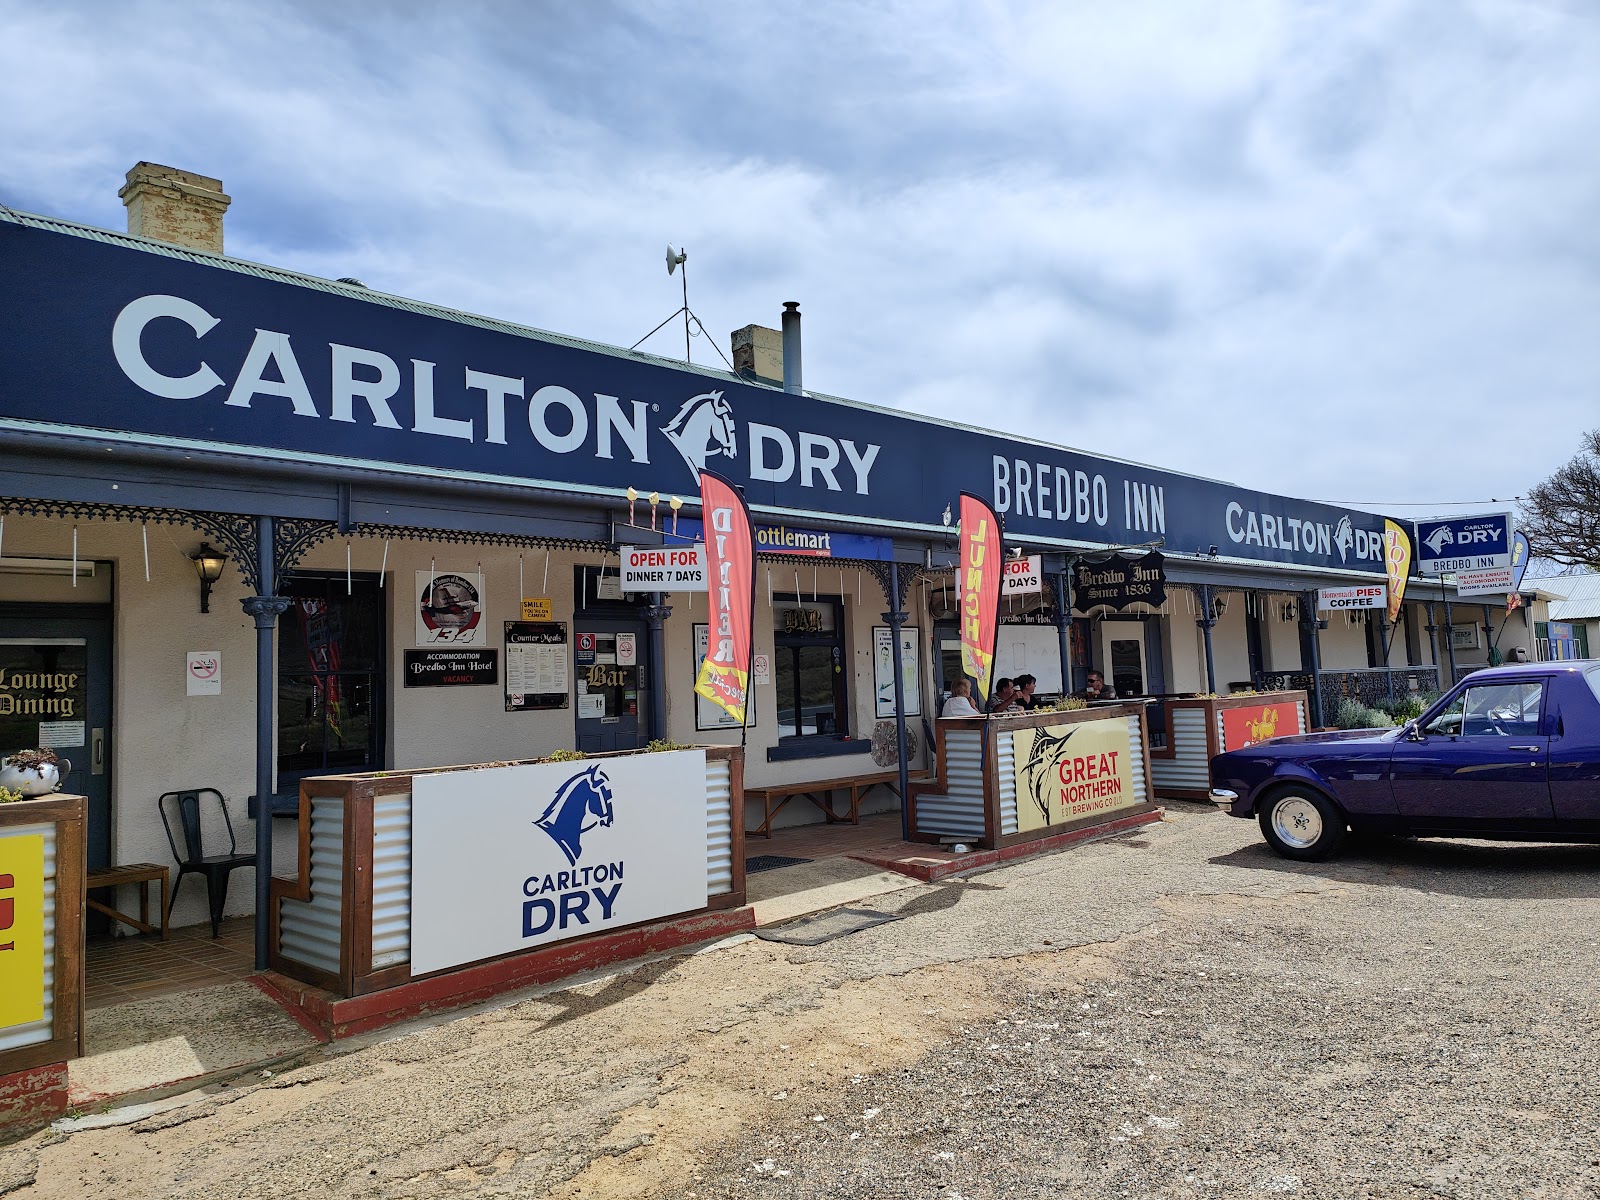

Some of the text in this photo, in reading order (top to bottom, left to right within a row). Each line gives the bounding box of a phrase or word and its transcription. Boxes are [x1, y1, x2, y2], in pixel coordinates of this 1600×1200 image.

[112, 294, 881, 495] CARLTON DRY
[992, 455, 1166, 534] BREDBO INN
[1225, 501, 1332, 556] CARLTON
[1464, 523, 1494, 531] CARLTON
[754, 526, 831, 549] ottlemart
[1457, 528, 1502, 545] DRY
[629, 551, 698, 567] OPEN FOR
[1433, 556, 1494, 571] BREDBO INN
[626, 570, 702, 582] DINNER 7 DAYS
[1009, 576, 1037, 588] DAYS
[1078, 561, 1160, 587] Bredbo Inn
[1087, 583, 1151, 600] Since 1836
[1321, 588, 1382, 599] Homemade PIES
[1330, 598, 1373, 607] COFFEE
[783, 608, 823, 633] BAR
[426, 628, 477, 644] 134
[511, 633, 562, 643] Counter Meals
[411, 661, 493, 674] Bredbo Inn Hotel
[585, 664, 628, 687] Bar
[0, 668, 79, 693] Lounge
[443, 675, 474, 683] VACANCY
[0, 693, 75, 718] Dining
[1059, 751, 1119, 785] GREAT
[1060, 777, 1122, 806] NORTHERN
[1061, 806, 1072, 817] EST
[1072, 799, 1104, 815] BREWING
[522, 860, 624, 897] CARLTON
[522, 882, 623, 938] DRY
